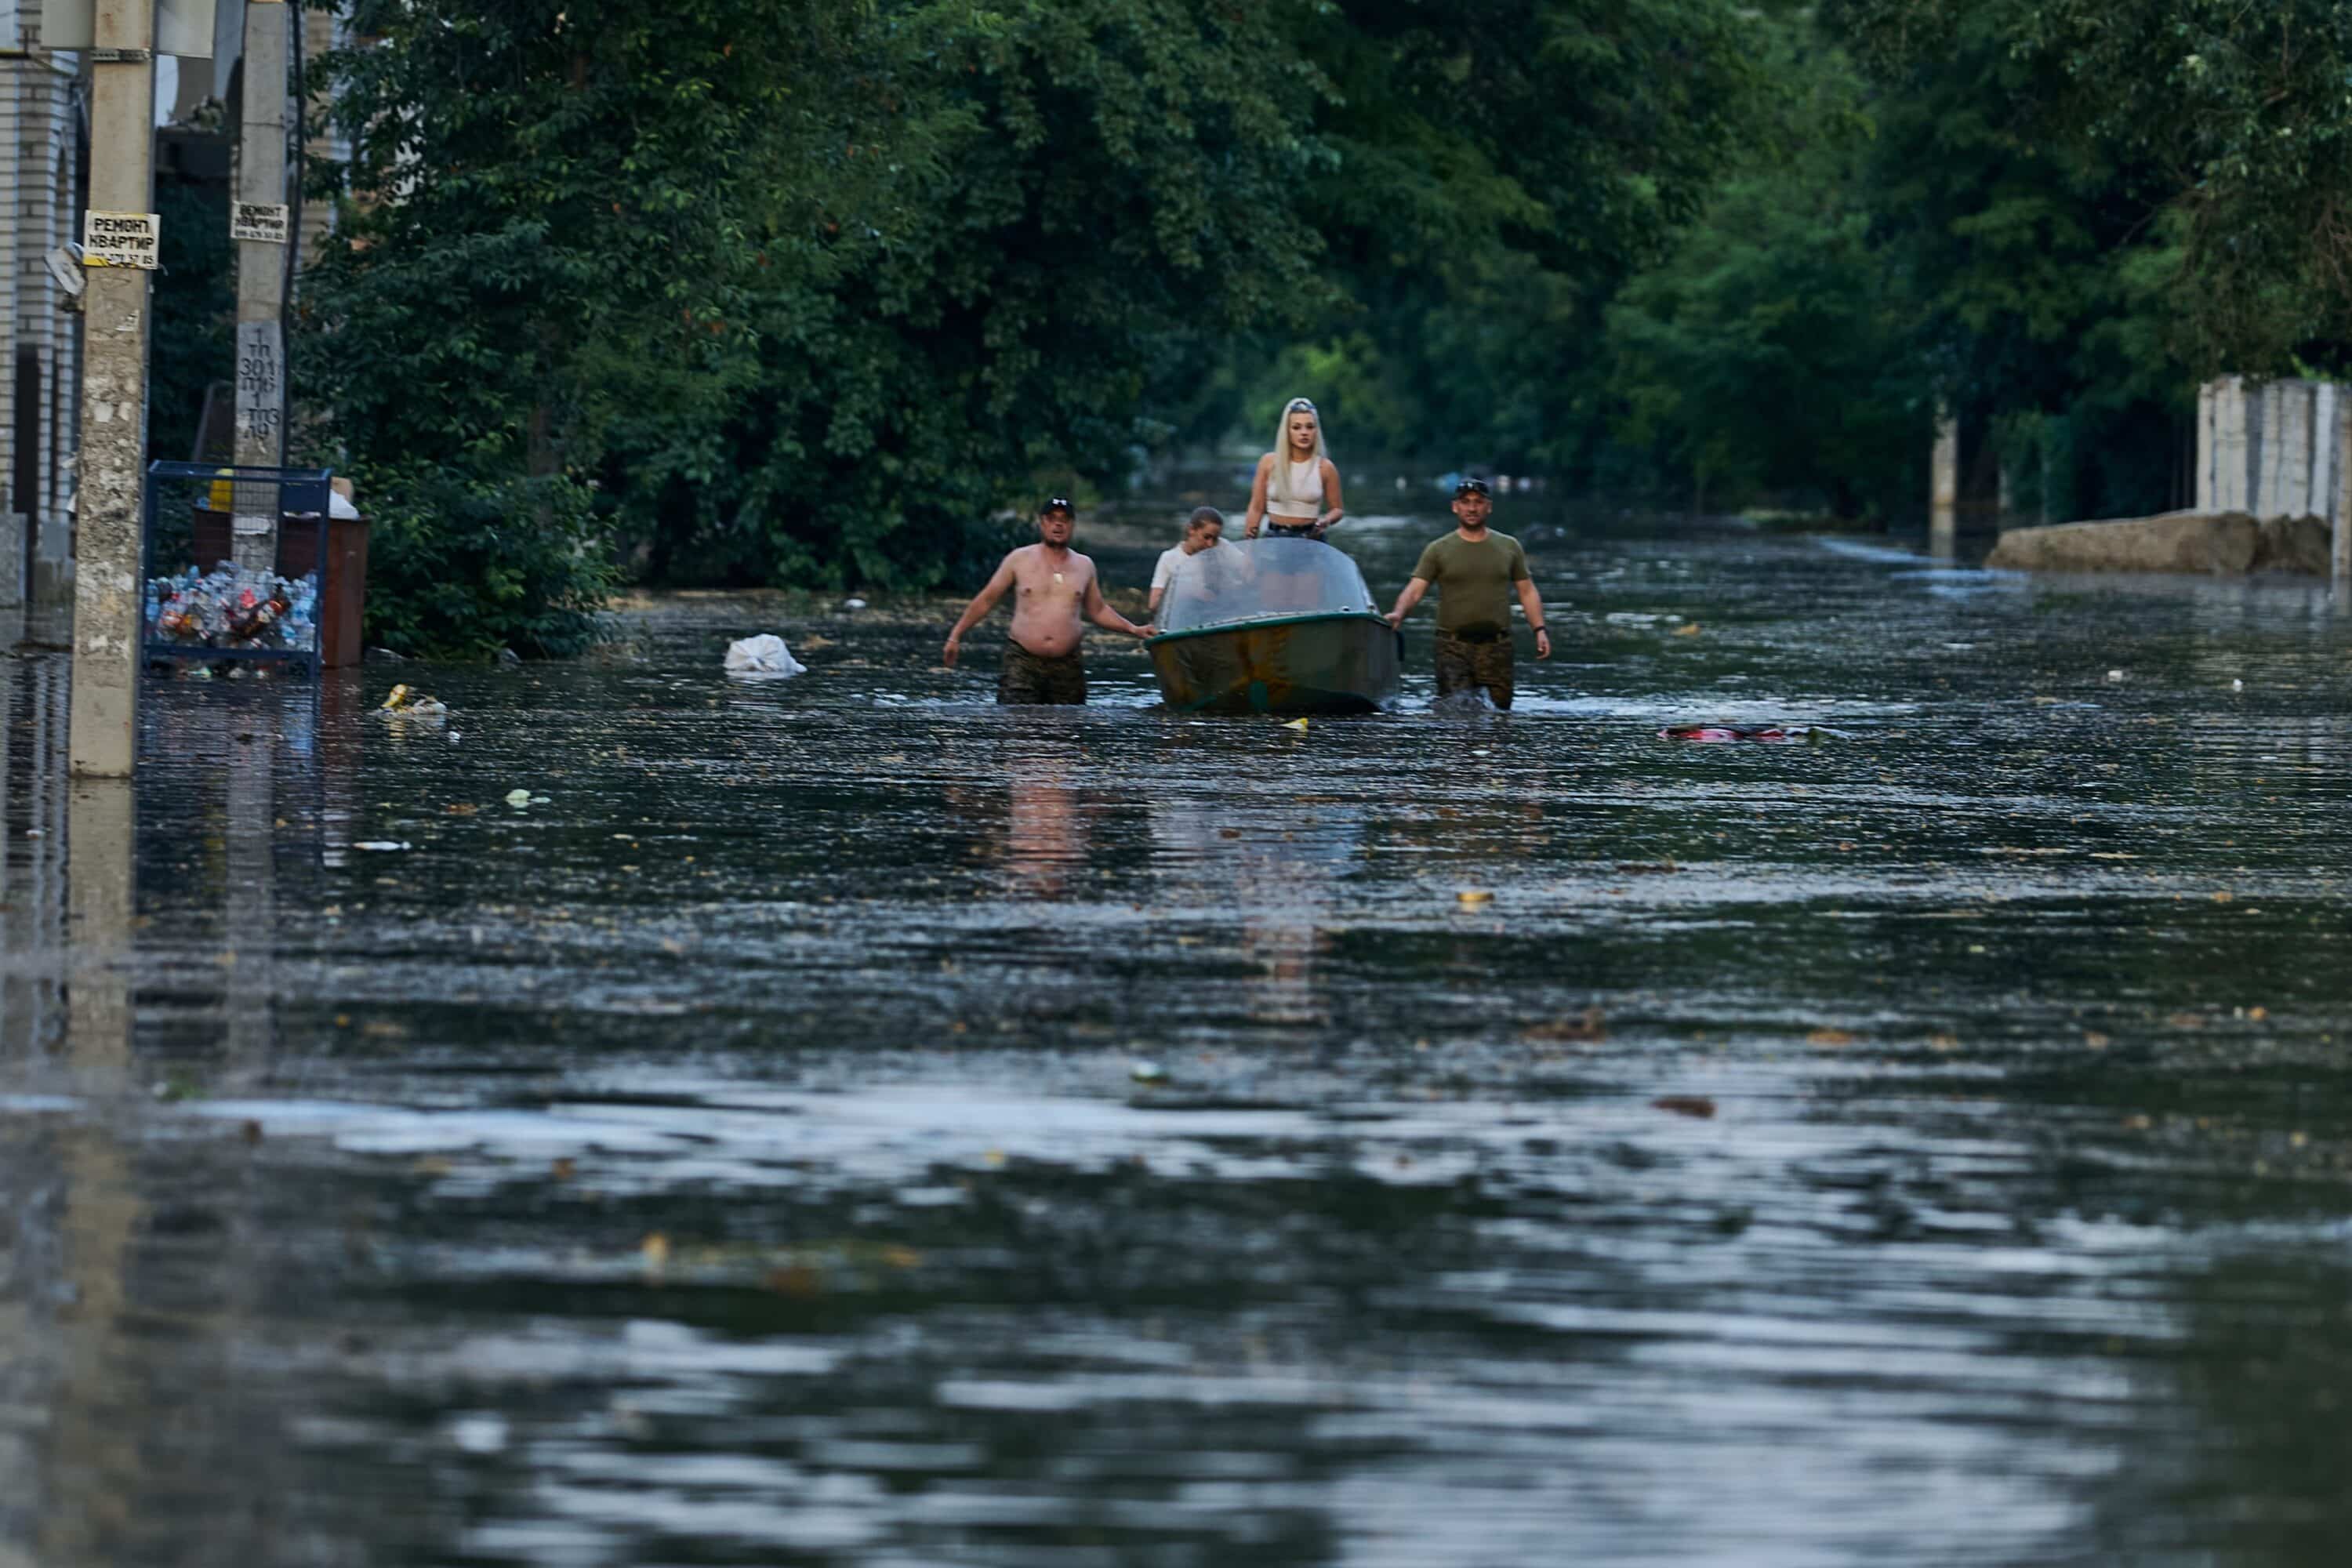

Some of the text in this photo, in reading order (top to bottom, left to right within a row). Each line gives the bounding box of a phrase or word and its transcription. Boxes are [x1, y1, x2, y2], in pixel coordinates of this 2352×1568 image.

[239, 205, 281, 216] РЕМОНТ
[94, 218, 149, 233] РЕМОНТ
[89, 234, 154, 250] КВАРТИР
[238, 357, 275, 376] 301
